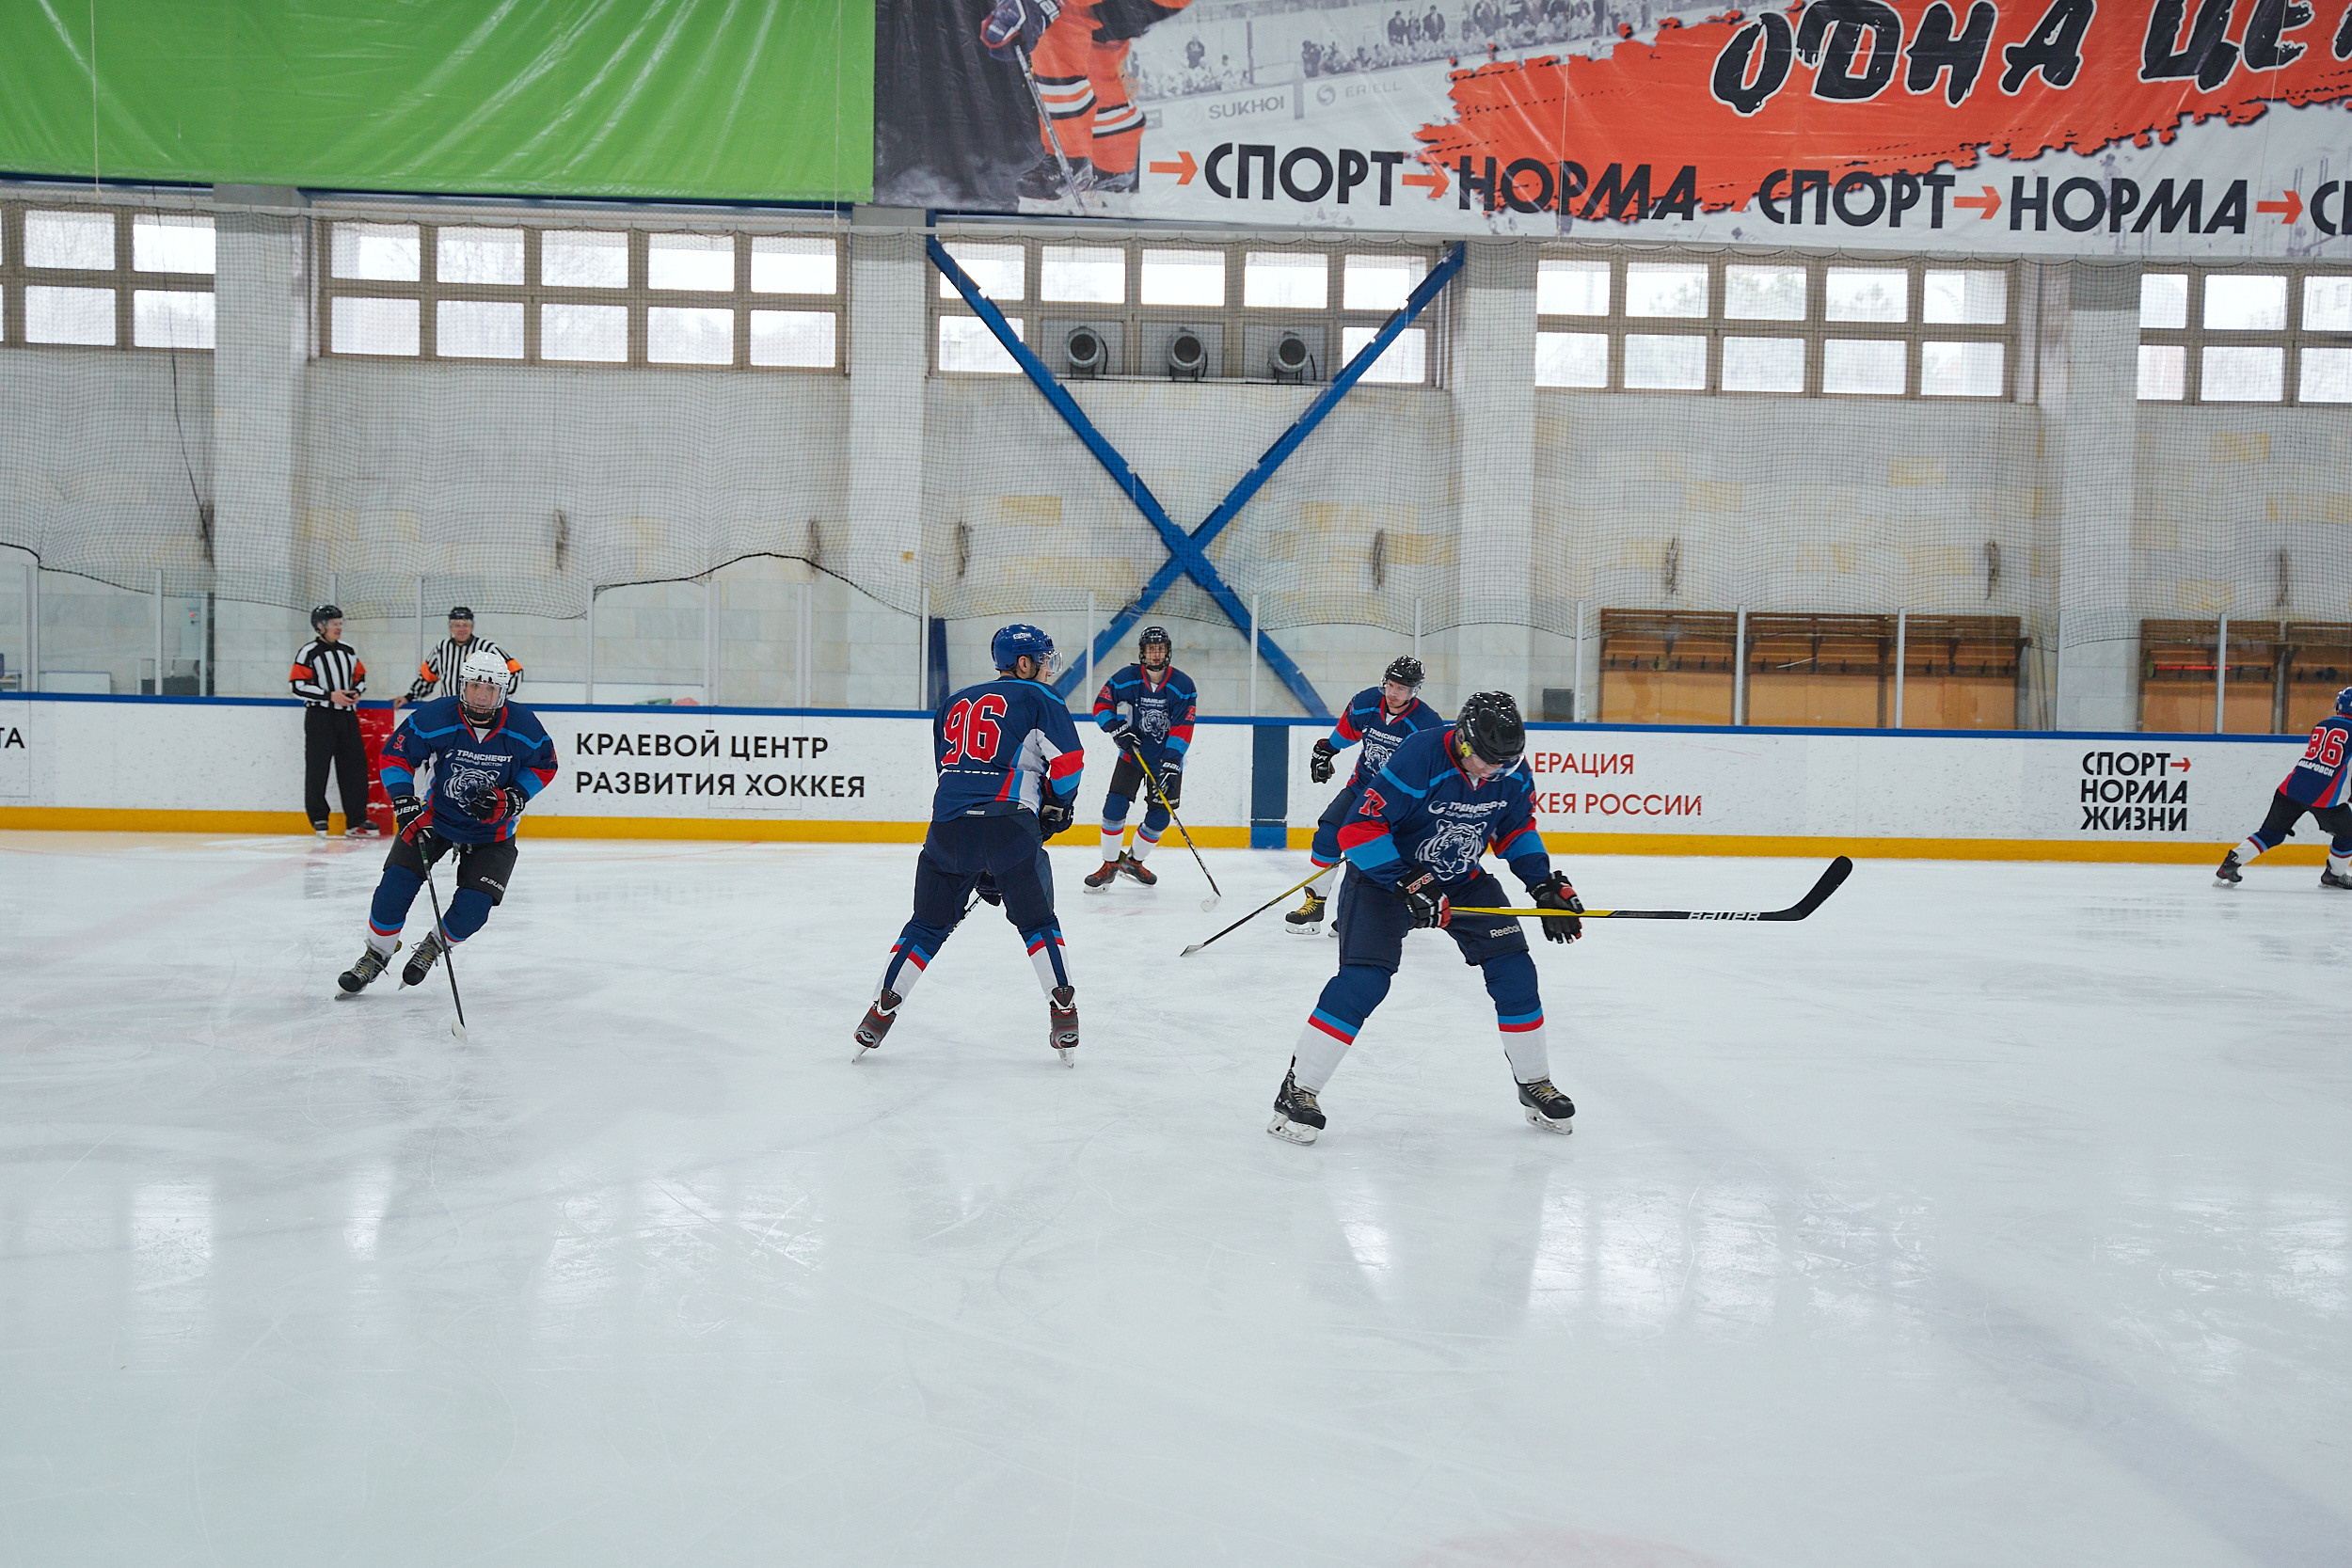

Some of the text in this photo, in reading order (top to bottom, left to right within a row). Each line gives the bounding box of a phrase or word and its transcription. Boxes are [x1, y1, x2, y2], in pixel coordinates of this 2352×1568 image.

[2137, 0, 2352, 94] ЦЕ
[1208, 95, 1285, 120] SUKHOI
[1204, 143, 1404, 206] СПОРТ
[1458, 155, 1697, 222] НОРМА
[1758, 169, 1955, 230] СПОРТ
[2009, 176, 2249, 234] НОРМА
[941, 693, 1009, 767] 96
[1369, 727, 1404, 743] ТРАНСНЕФ
[456, 749, 514, 763] ТРАНСНЕФТ
[576, 729, 720, 757] КРАЕВОЙ
[731, 736, 829, 761] ЦЕНТР
[2304, 726, 2349, 768] 86
[1525, 752, 1634, 778] ЕРАЦИЯ
[2082, 752, 2171, 777] СПОРТ
[576, 771, 866, 798] РАЗВИТИЯ ХОККЕЯ
[2080, 779, 2188, 804] НОРМА
[394, 803, 421, 816] UER
[1535, 792, 1577, 814] КЕЯ
[1585, 793, 1702, 816] РОССИИ
[2080, 806, 2188, 832] ЖИЗНИ
[1406, 872, 1435, 895] CC
[1688, 911, 1761, 922] BAUER
[1489, 924, 1521, 939] Reebok
